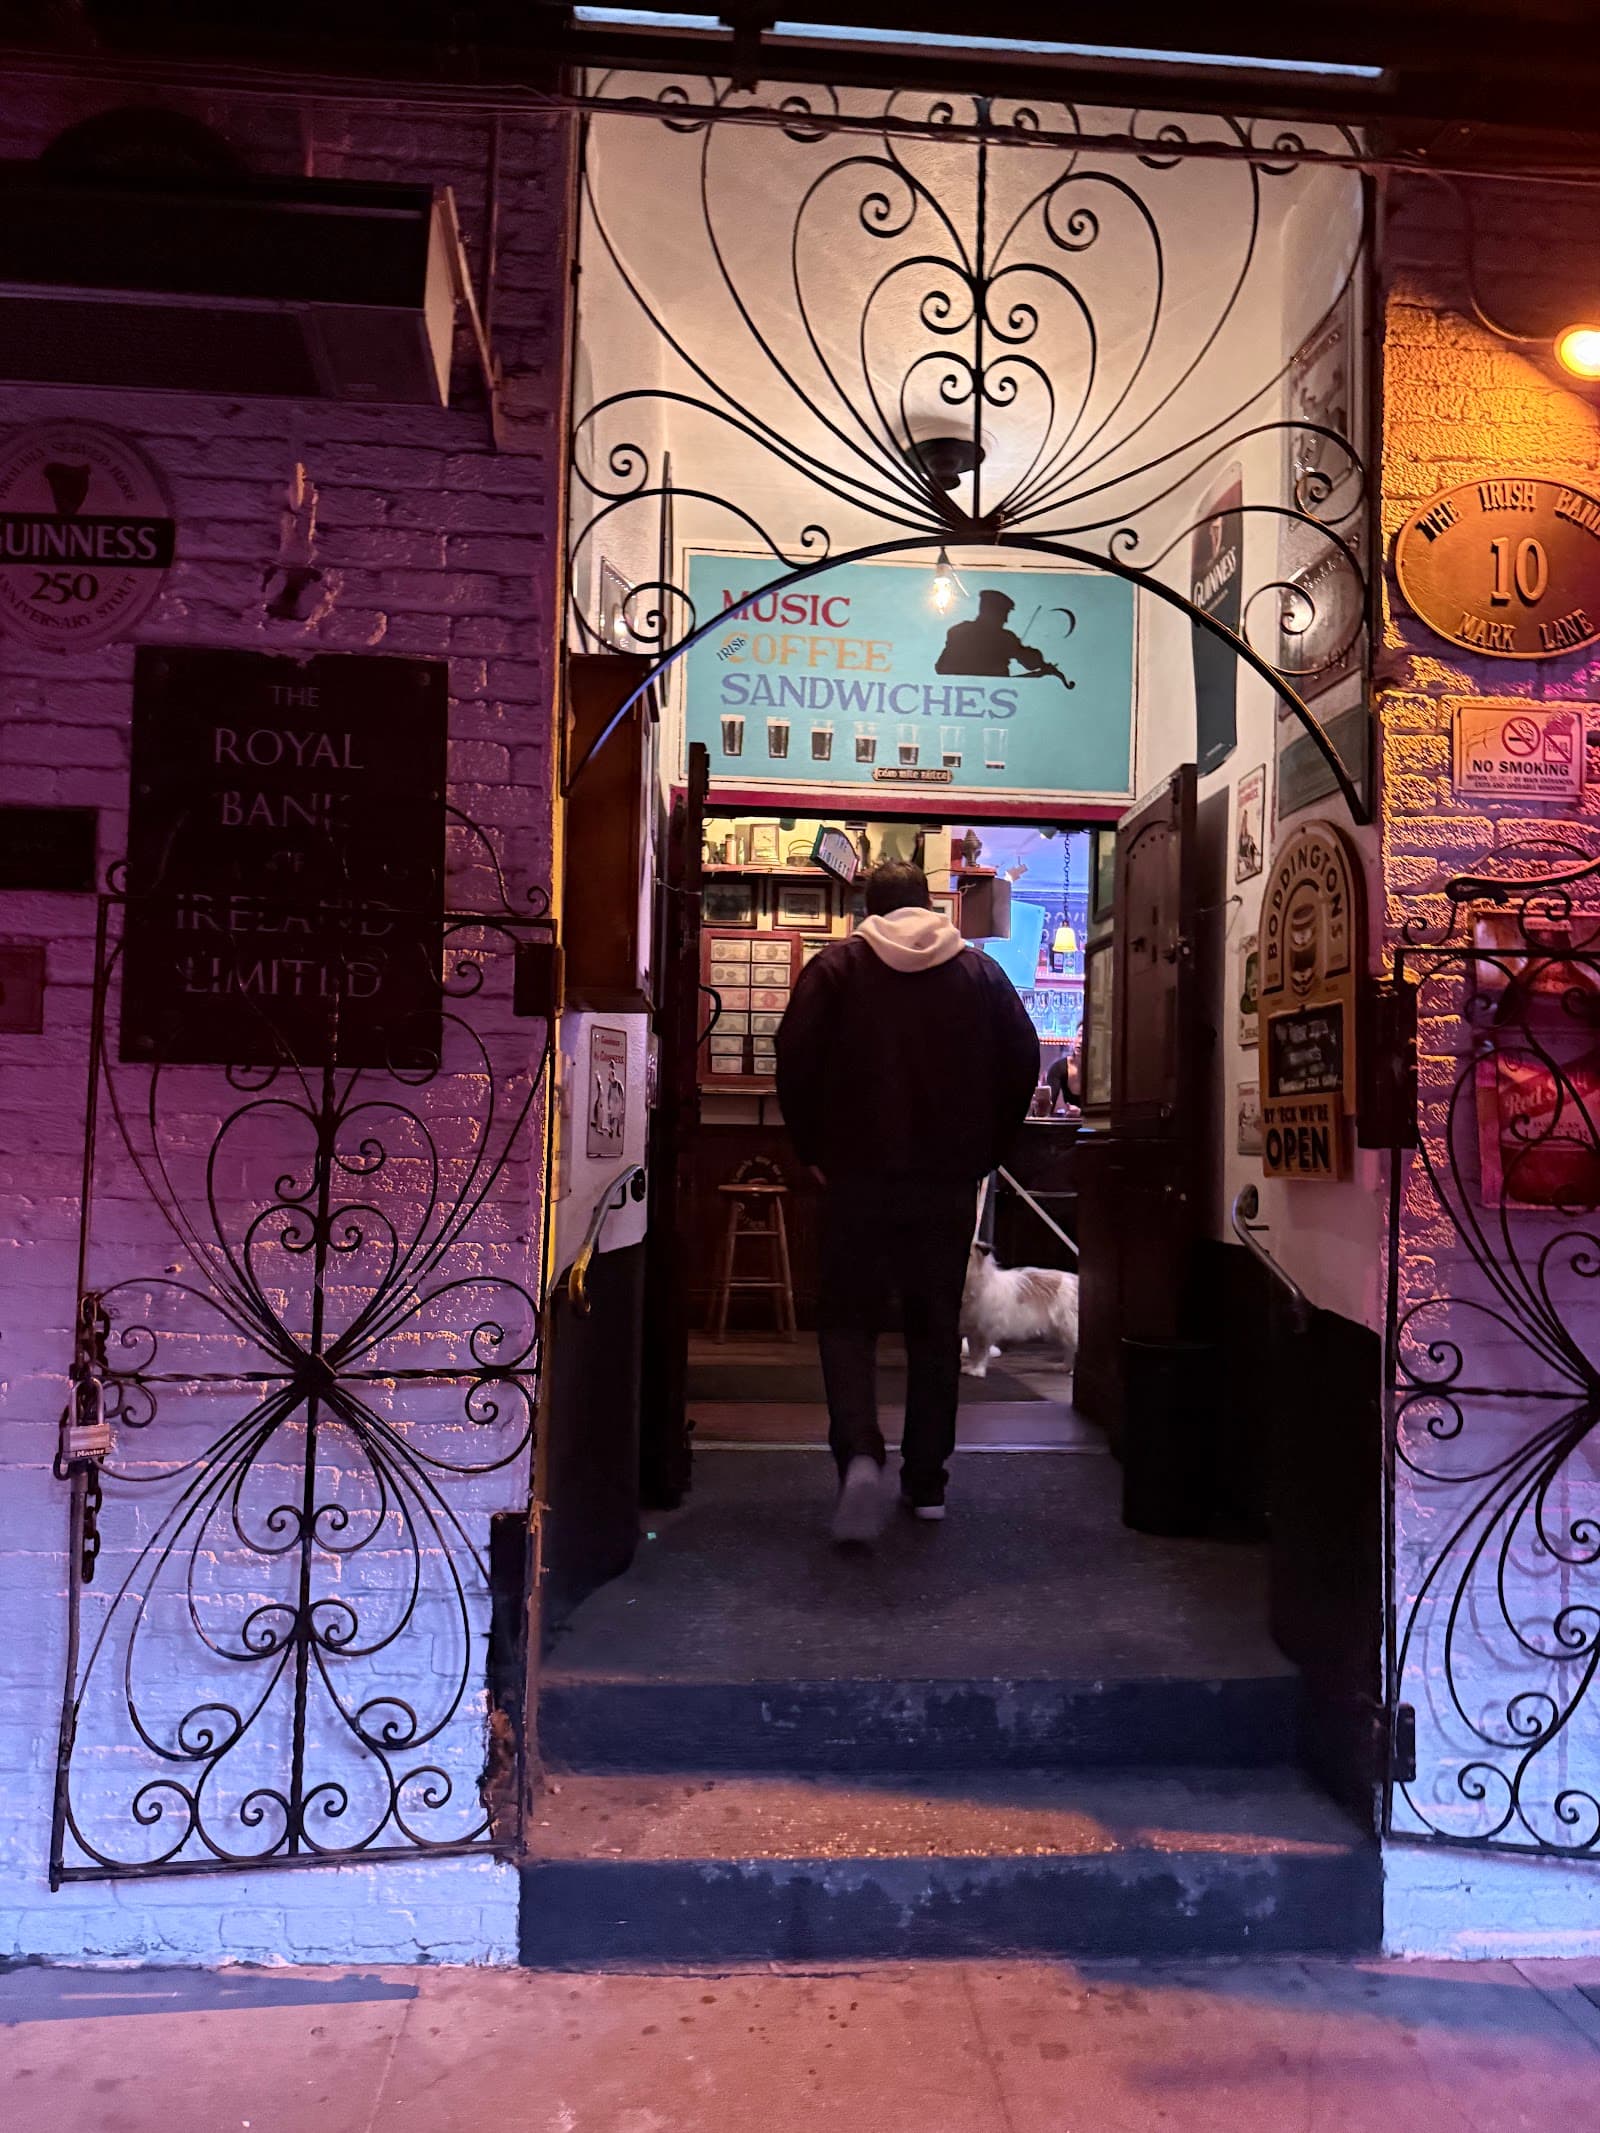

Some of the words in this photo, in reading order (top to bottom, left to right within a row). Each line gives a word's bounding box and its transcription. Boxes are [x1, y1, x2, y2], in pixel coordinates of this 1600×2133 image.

[1418, 501, 1463, 541] THE
[1478, 481, 1537, 511] IRISH
[1553, 486, 1600, 537] BAN
[0, 521, 159, 562] UINNESS
[31, 572, 98, 606] 250
[1491, 536, 1549, 603] 10
[97, 575, 137, 619] STOUT
[721, 589, 851, 628] MUSIC
[1454, 611, 1516, 651] MARK
[1539, 609, 1594, 650] LANE
[720, 631, 894, 674] COFFEE
[270, 685, 321, 709] THE
[719, 672, 1019, 720] SANDWICHES
[214, 727, 366, 770] ROYAL
[1472, 759, 1494, 773] NO
[1499, 761, 1569, 776] SMOKING
[1267, 844, 1344, 960] BODDINGTONS
[1264, 1107, 1276, 1124] BY
[1265, 1126, 1331, 1173] OPEN
[77, 1448, 105, 1458] Master
